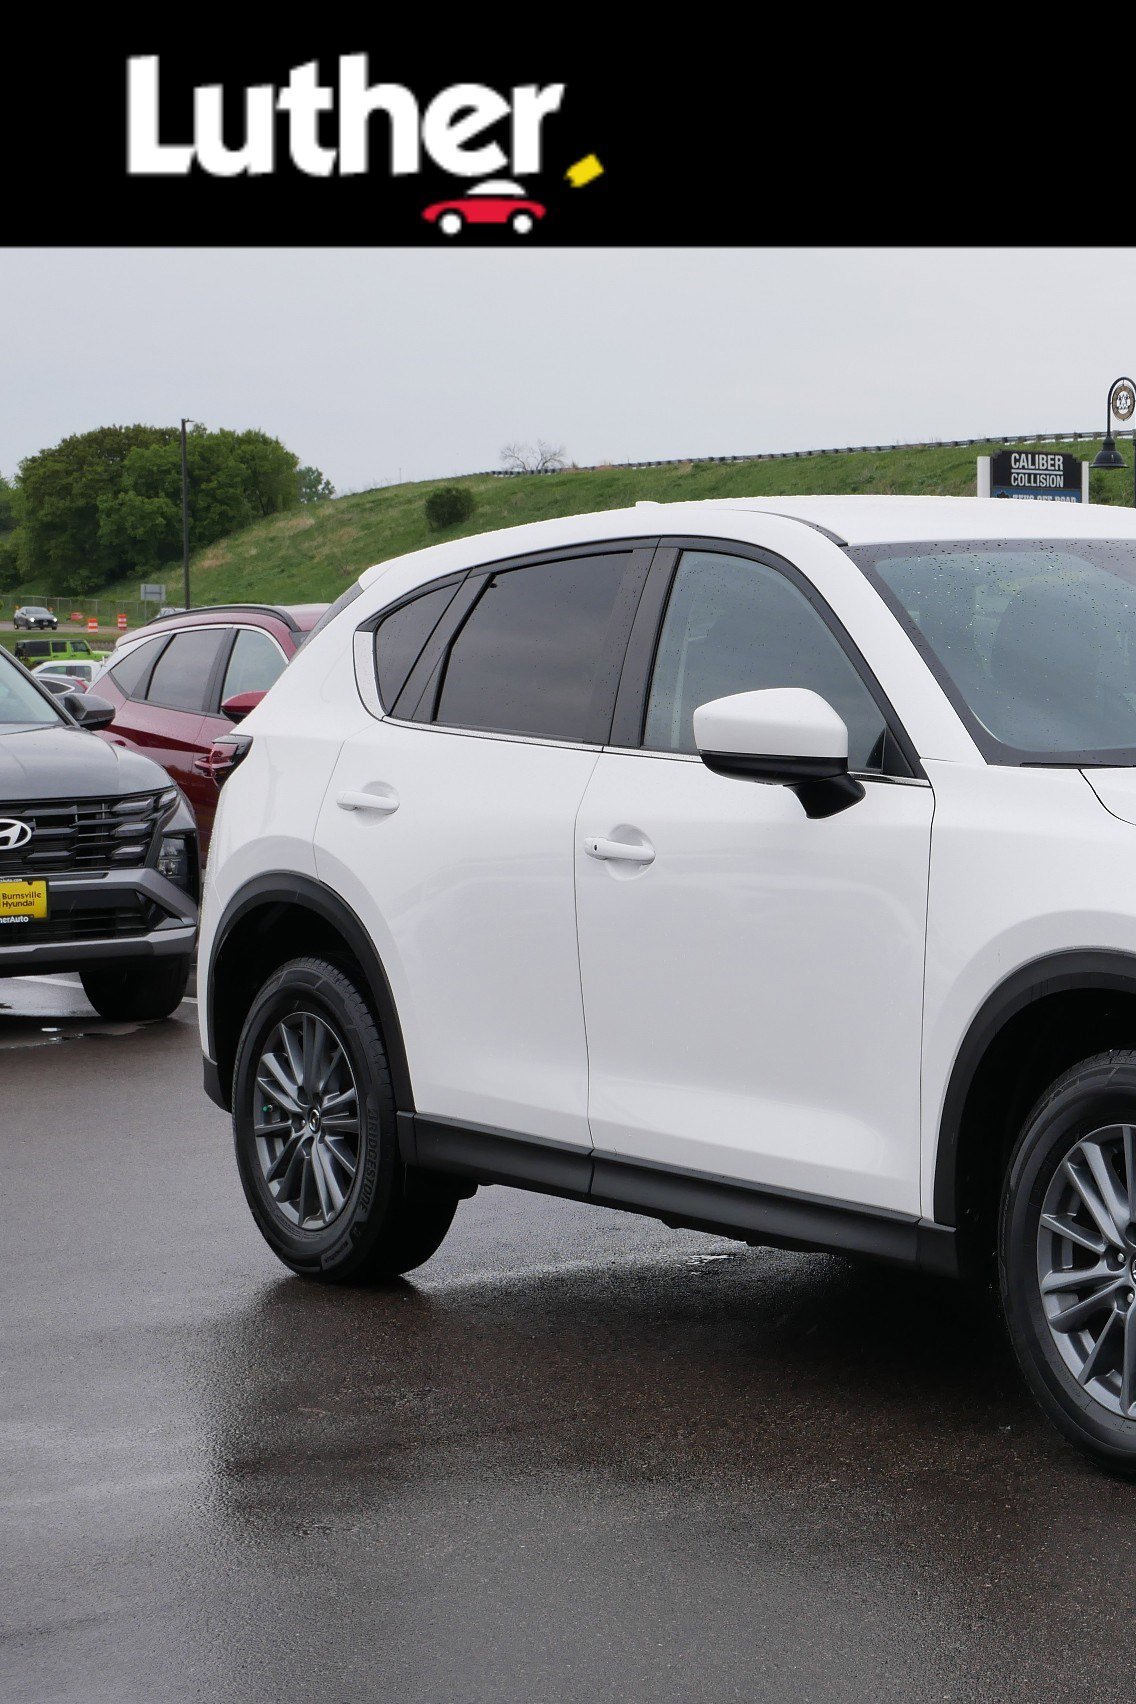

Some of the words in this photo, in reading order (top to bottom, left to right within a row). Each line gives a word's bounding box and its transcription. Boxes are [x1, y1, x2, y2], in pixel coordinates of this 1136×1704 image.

[1011, 453, 1064, 471] CALIBER
[1011, 473, 1064, 488] COLLISION
[2, 891, 42, 900] Burnsville
[2, 900, 35, 909] Hyundai
